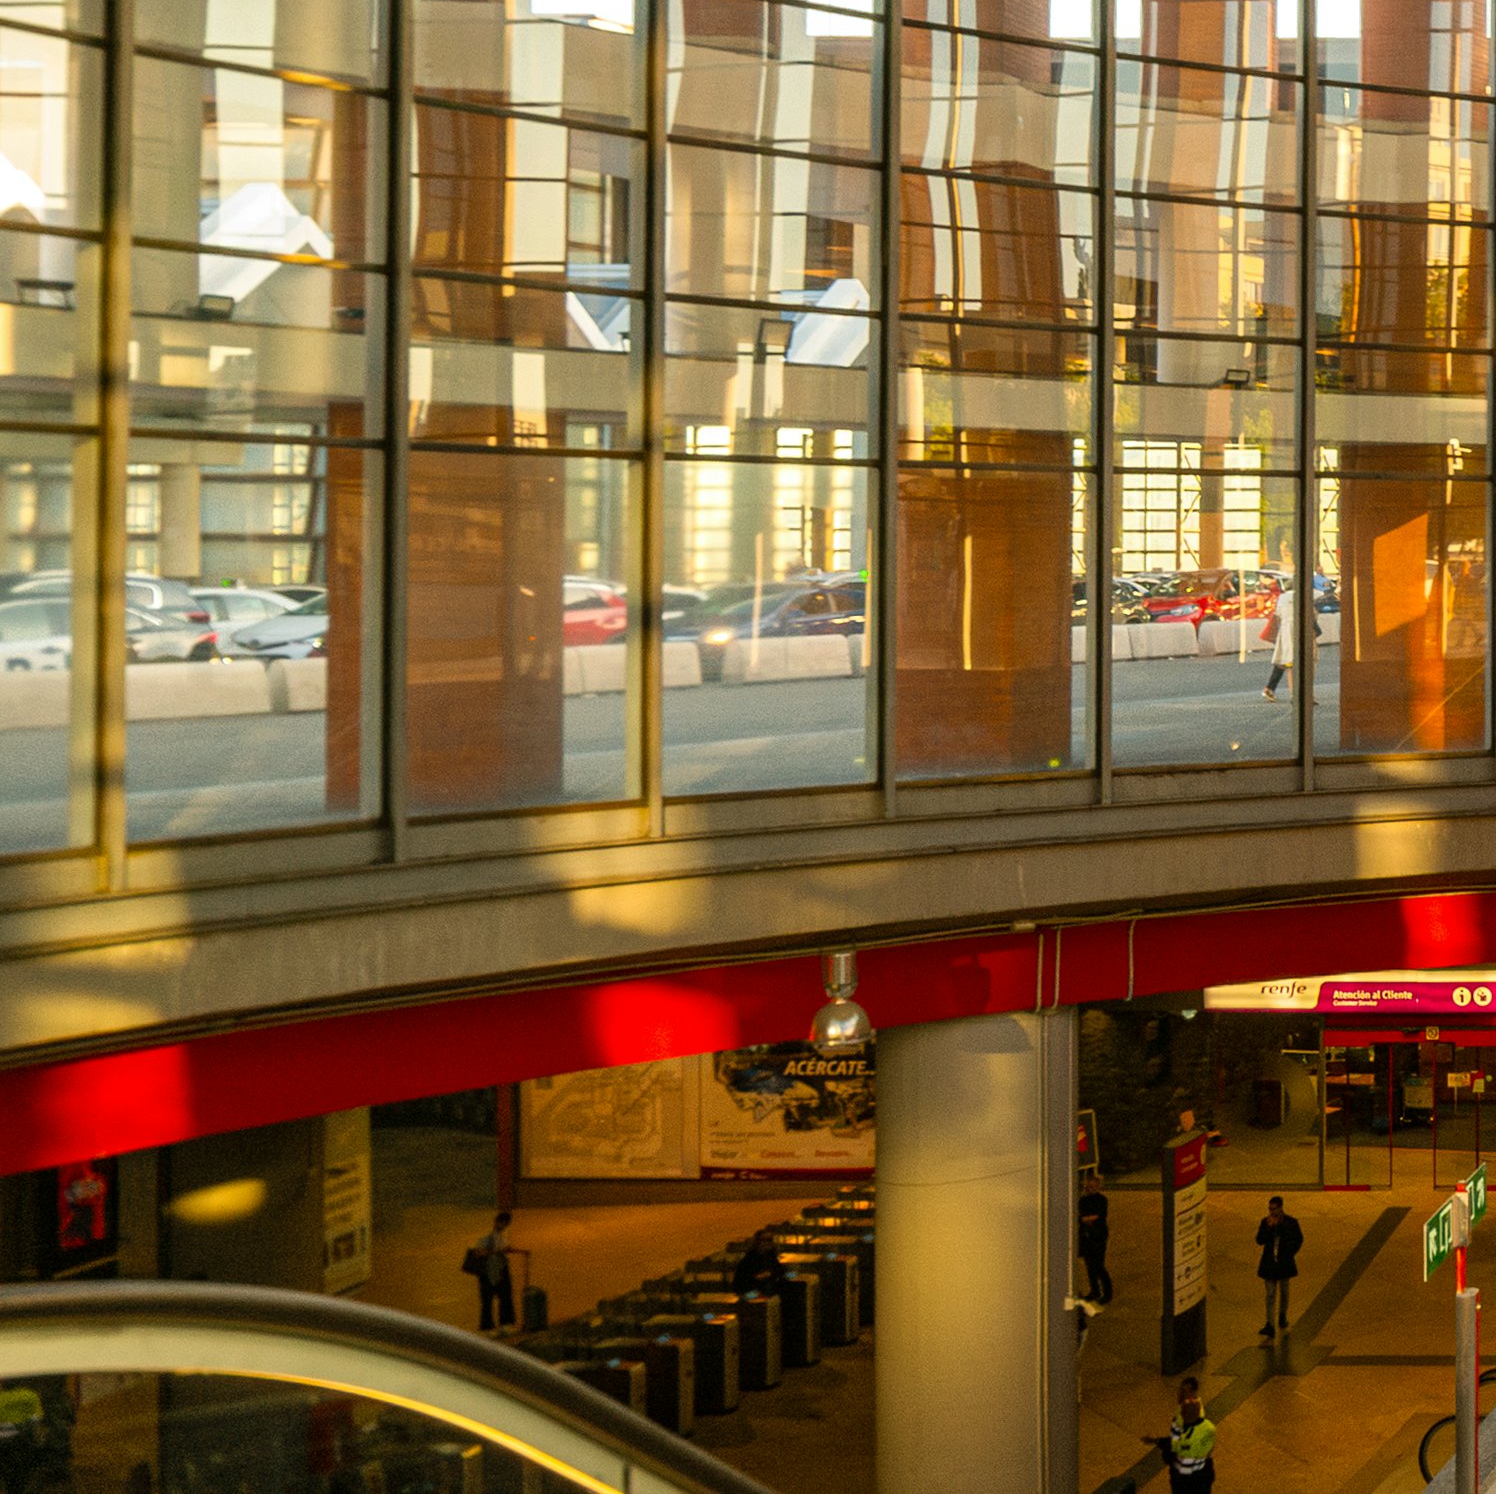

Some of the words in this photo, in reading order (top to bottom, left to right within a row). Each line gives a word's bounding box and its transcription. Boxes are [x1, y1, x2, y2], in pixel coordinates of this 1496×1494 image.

[1261, 981, 1307, 998] renfe
[1333, 989, 1371, 1000] Atención
[1372, 989, 1381, 1000] al
[1382, 989, 1413, 1000] Cliente
